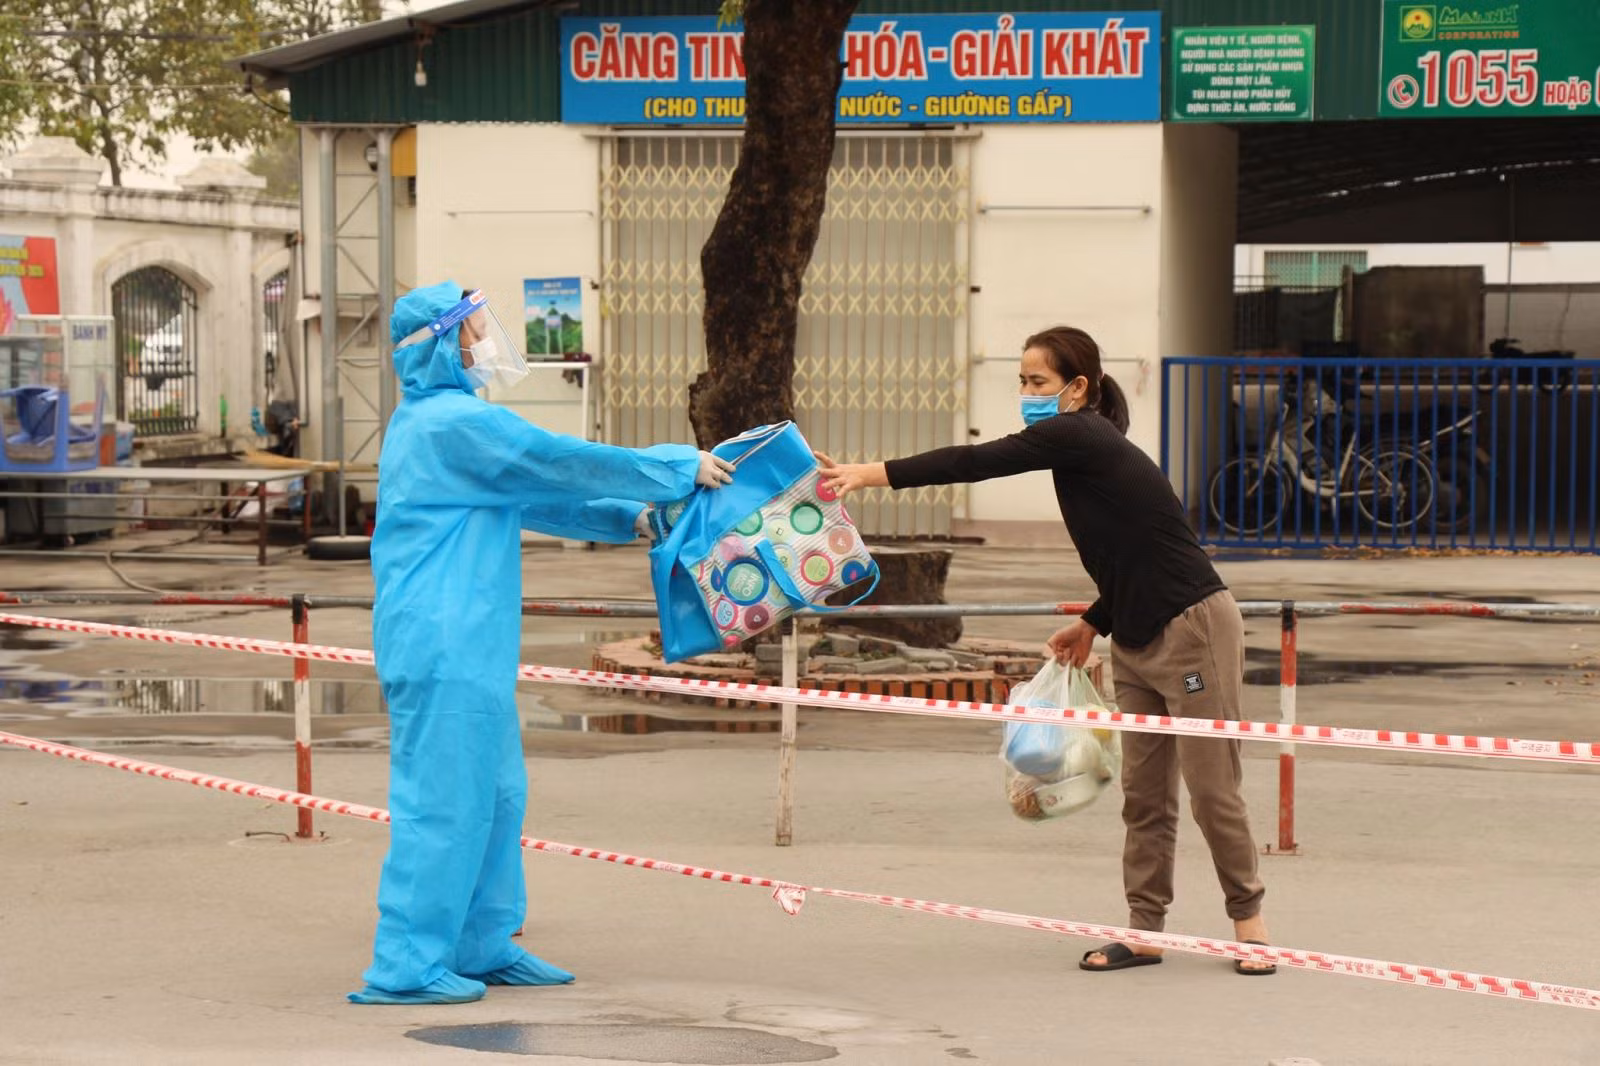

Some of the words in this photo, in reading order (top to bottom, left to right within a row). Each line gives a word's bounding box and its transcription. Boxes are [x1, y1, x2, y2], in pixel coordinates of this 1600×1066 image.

[571, 23, 679, 82] CĂNG
[686, 31, 747, 82] TIN
[1041, 18, 1150, 79] KHÁT
[1439, 31, 1520, 40] CORPORATION
[1417, 49, 1538, 107] 1055
[1543, 76, 1591, 110] HOẶC
[644, 97, 697, 119] (CHO
[839, 91, 902, 117] NƯỚC
[924, 91, 1011, 117] GIƯỜNG
[1017, 88, 1073, 117] GẤP)
